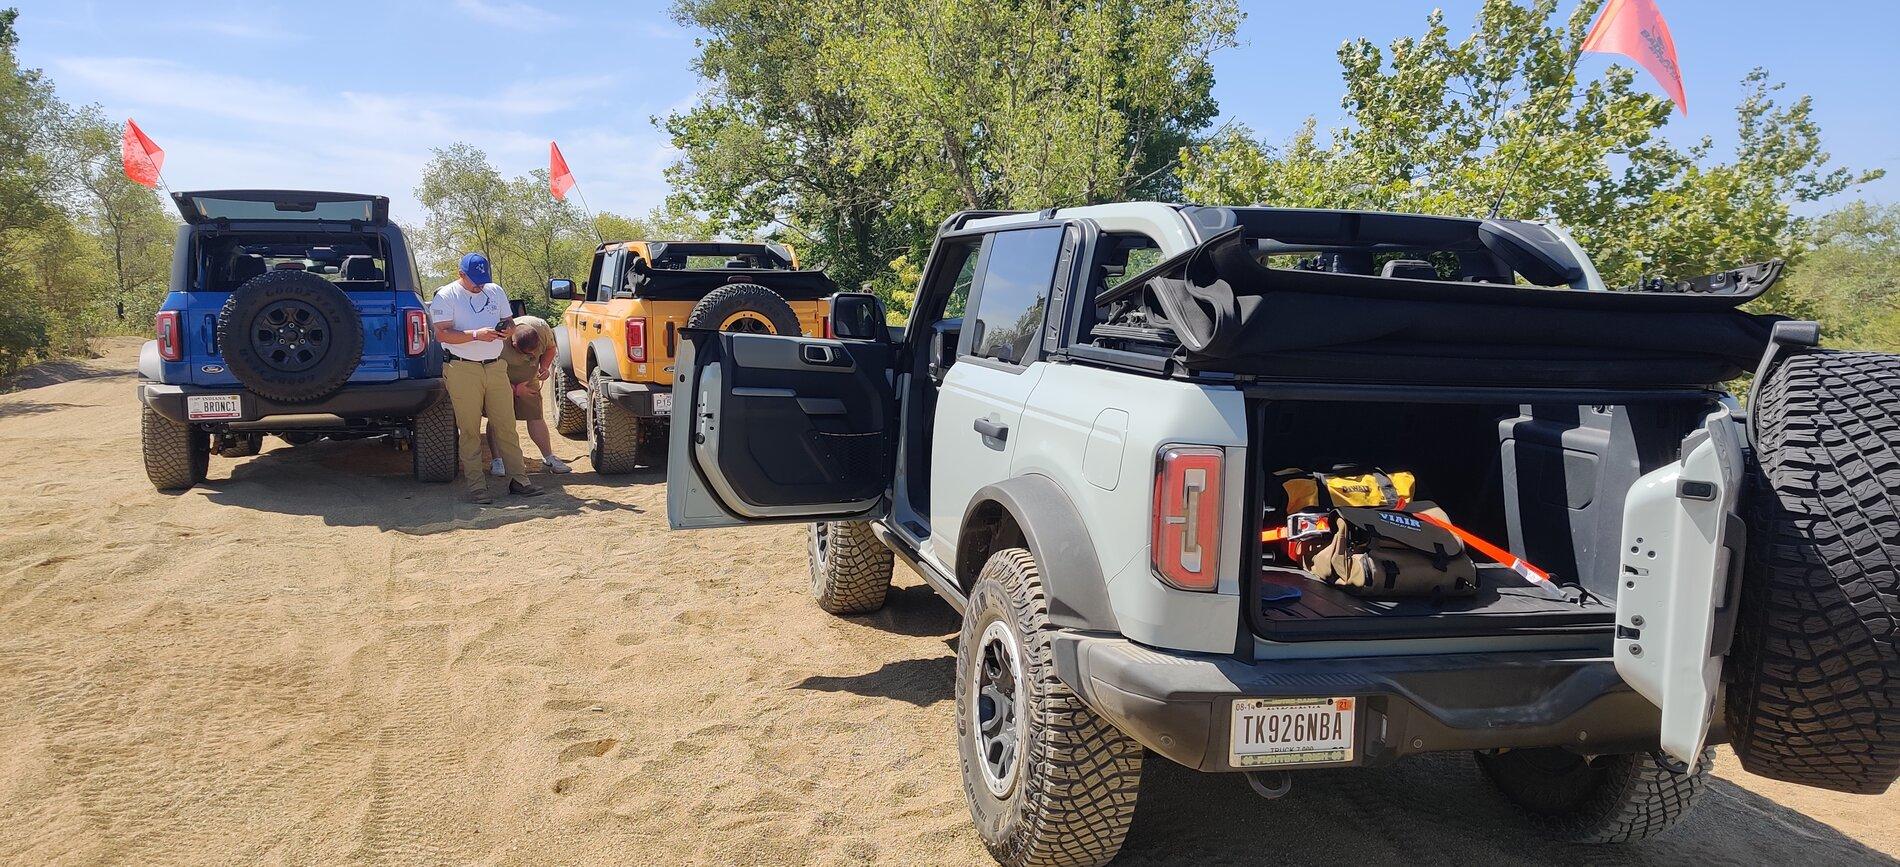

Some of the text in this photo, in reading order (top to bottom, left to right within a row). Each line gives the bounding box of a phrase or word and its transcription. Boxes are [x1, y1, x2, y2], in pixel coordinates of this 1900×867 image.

[203, 401, 236, 412] BRONC1
[1379, 512, 1421, 528] VIAIR
[956, 590, 989, 738] GOODYEAR
[1339, 701, 1348, 709] 21
[1243, 712, 1343, 745] TK926NBA
